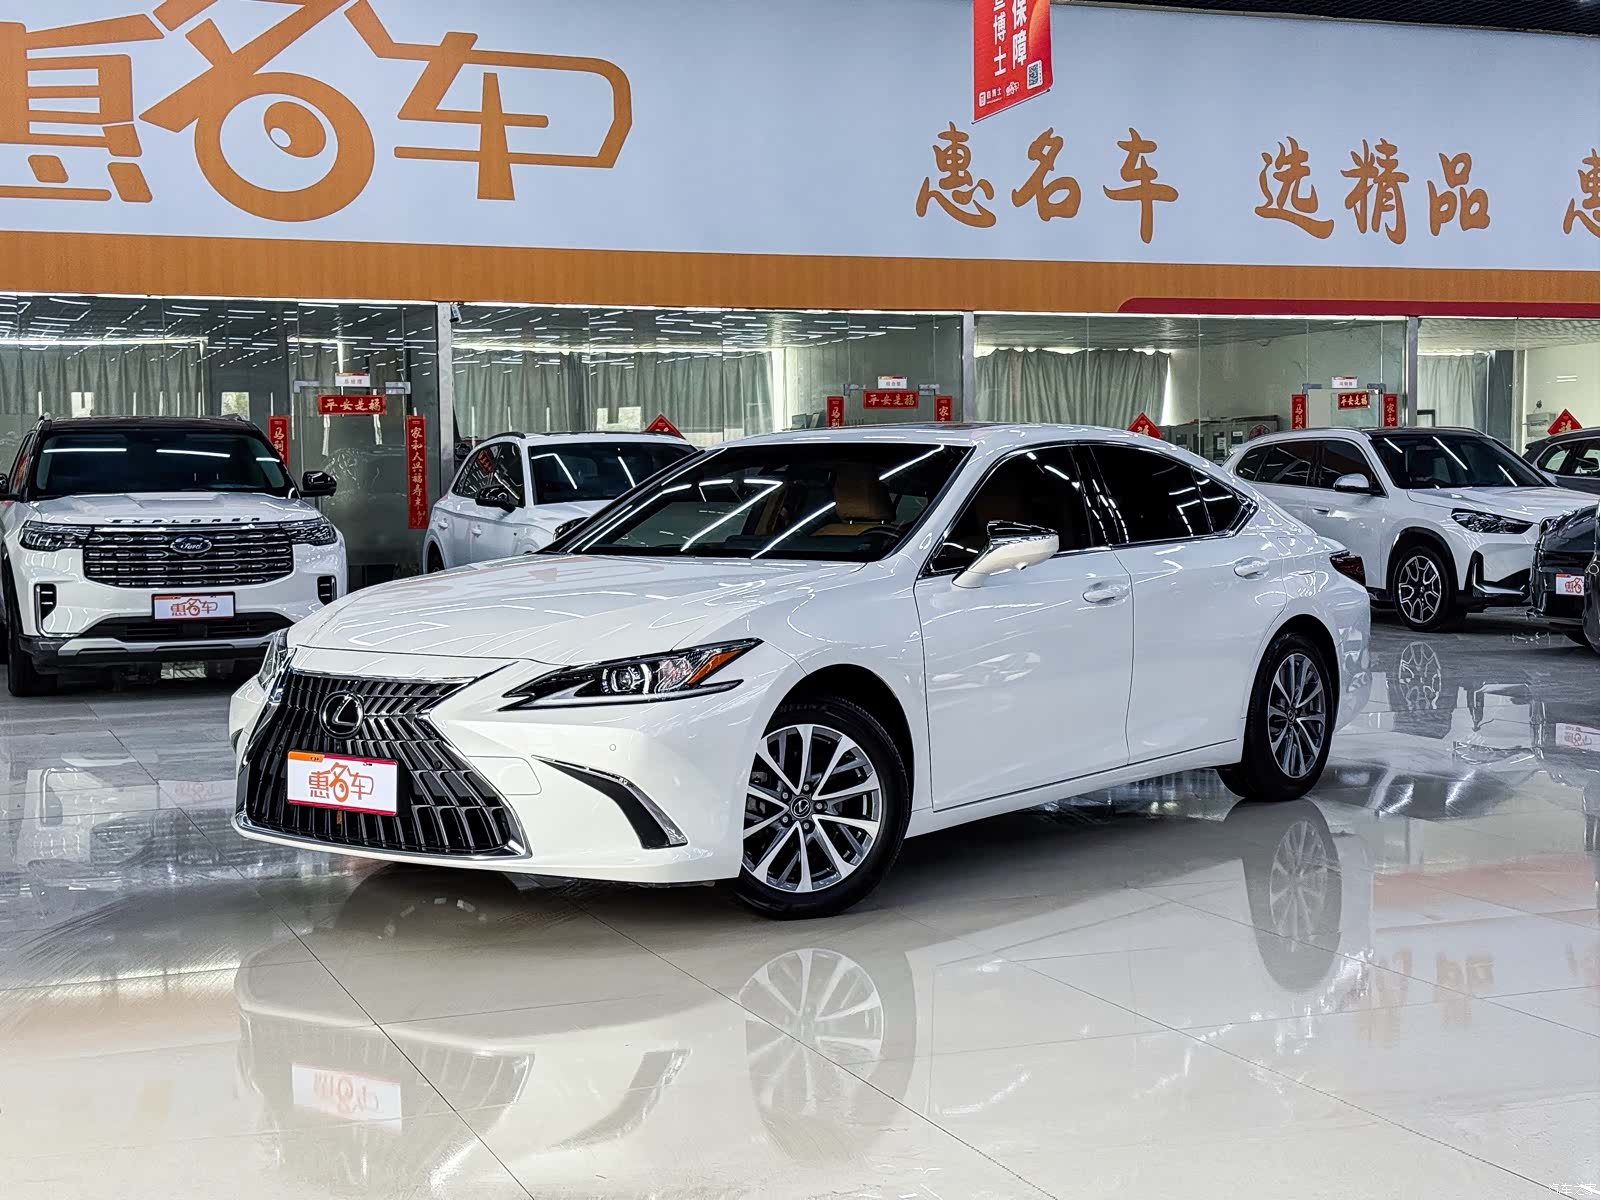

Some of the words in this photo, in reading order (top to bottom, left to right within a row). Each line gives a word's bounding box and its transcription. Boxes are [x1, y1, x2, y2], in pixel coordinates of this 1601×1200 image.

[915, 121, 1179, 244] 惠名车
[1254, 135, 1491, 245] 选精品
[323, 398, 381, 412] 平安是福
[868, 393, 915, 406] 平安是福
[1340, 393, 1368, 407] 平安是福
[180, 541, 203, 550] Ford
[170, 598, 219, 616] 惠名车
[308, 762, 375, 803] 惠名车
